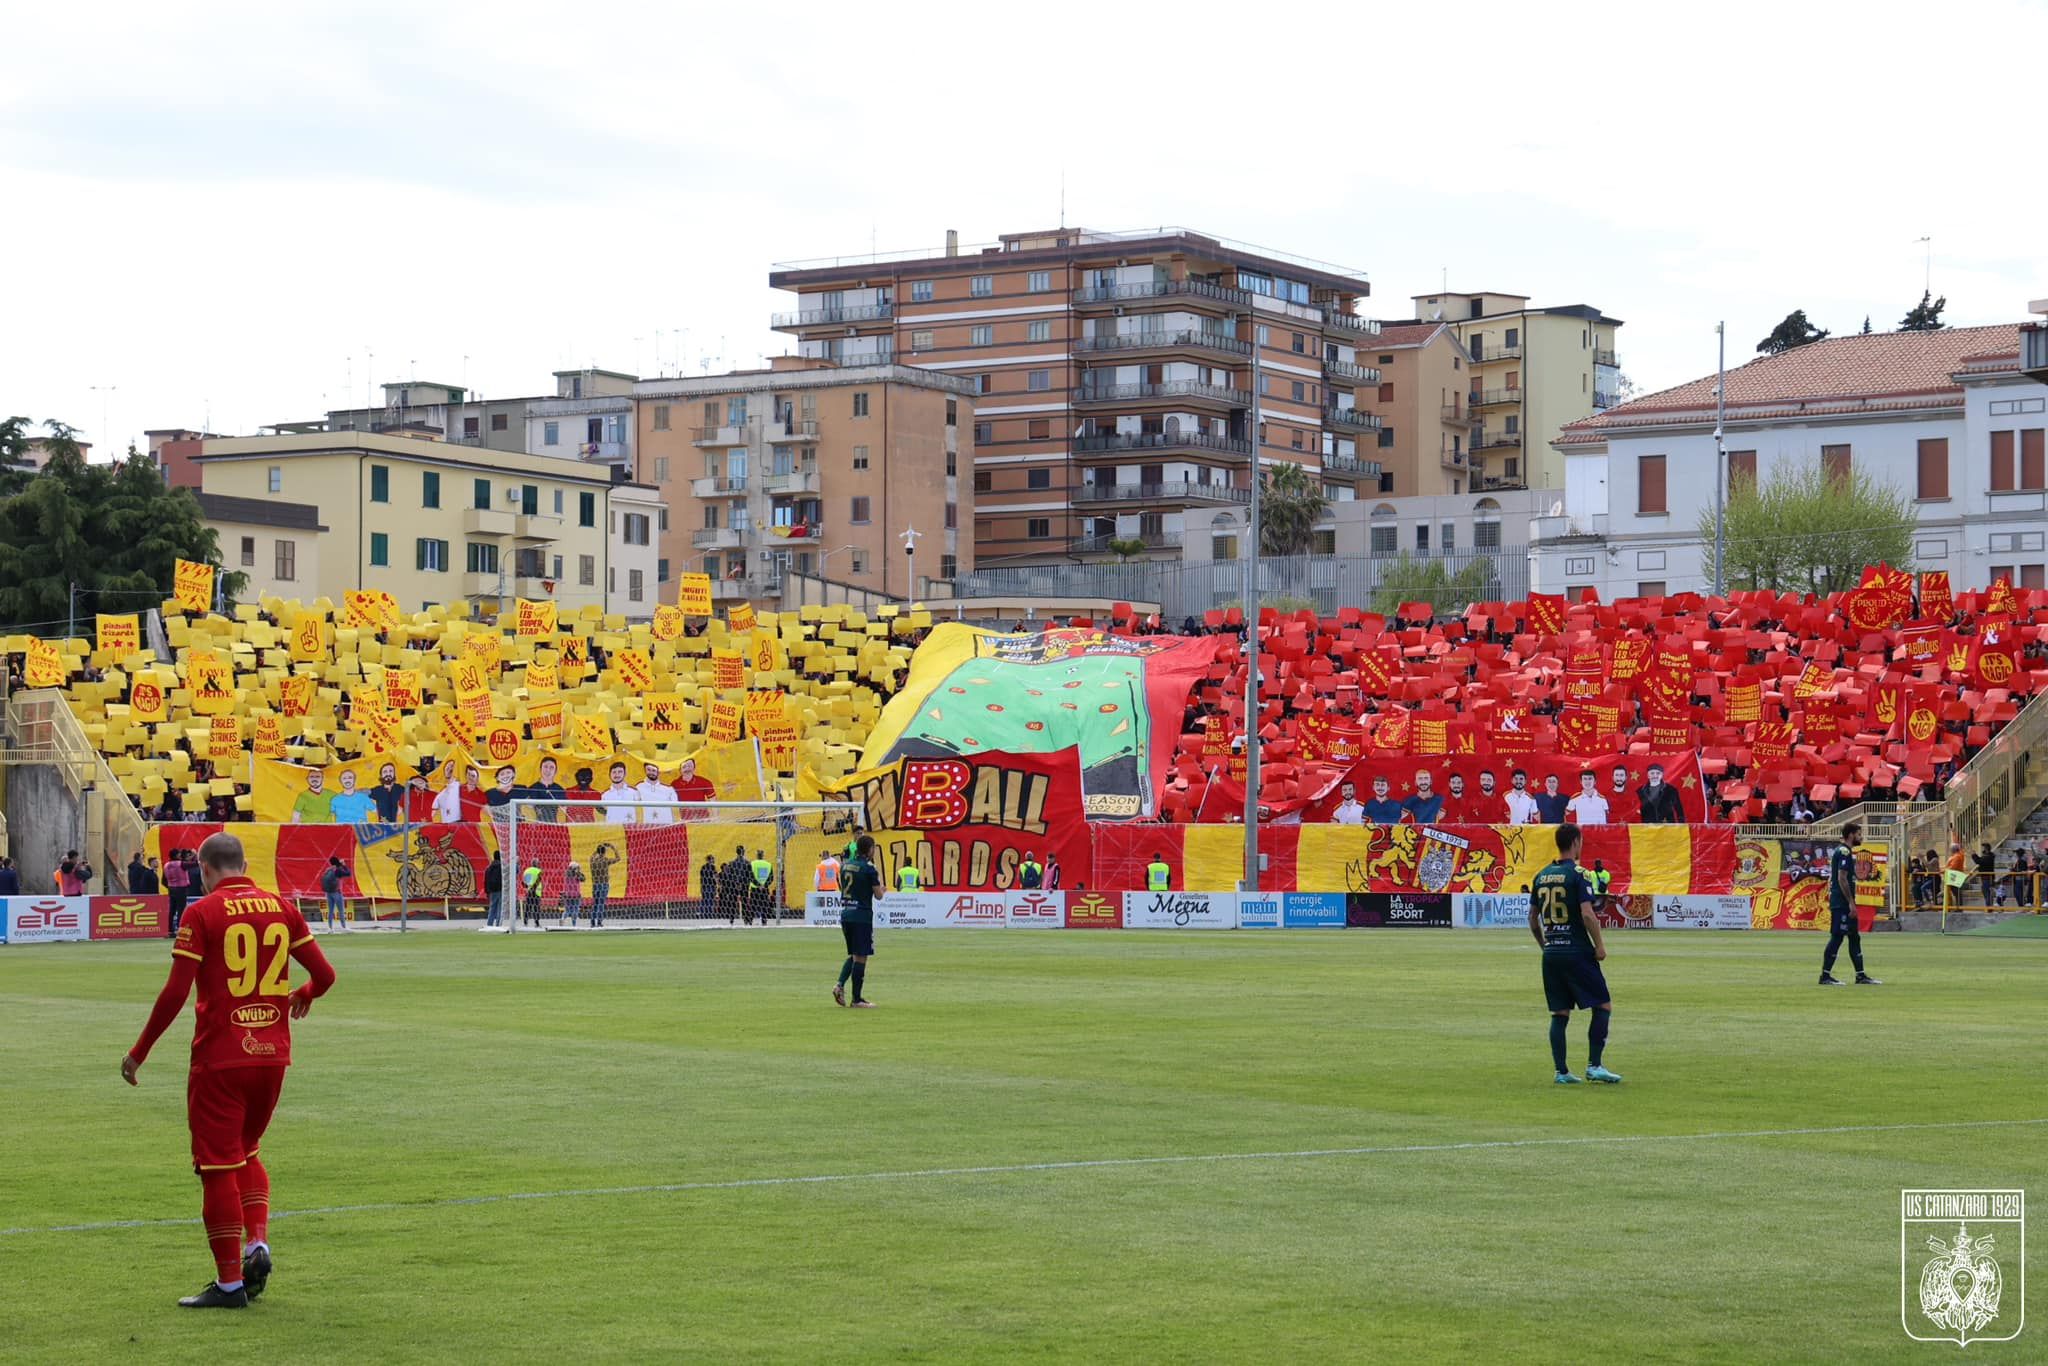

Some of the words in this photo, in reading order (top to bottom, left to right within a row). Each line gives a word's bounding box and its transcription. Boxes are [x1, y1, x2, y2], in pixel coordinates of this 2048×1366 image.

[520, 611, 531, 619] LES
[104, 622, 132, 631] pinball
[663, 620, 673, 628] OF
[1981, 624, 2006, 634] LOVE
[1984, 630, 1999, 645] &
[560, 639, 584, 647] LOVE
[1616, 640, 1631, 650] EAG
[1905, 641, 1939, 654] FABULOUS
[564, 647, 580, 660] &
[1614, 650, 1629, 659] LES
[1660, 652, 1688, 661] pinball
[559, 658, 584, 666] PRIDE
[1613, 660, 1638, 669] SUPER
[1984, 655, 2001, 667] IT'S
[200, 669, 226, 678] LOVE
[1611, 669, 1633, 678] STAR
[1982, 666, 2012, 681] MAGIC
[387, 680, 399, 688] LES
[1567, 682, 1600, 695] FABULOUS
[196, 690, 232, 699] PRIDE
[649, 703, 679, 711] LOVE
[713, 704, 737, 717] EAGLES
[653, 709, 671, 725] &
[1497, 708, 1526, 717] LOVE
[211, 717, 235, 729] EAGLES
[646, 722, 681, 732] PRIDE
[711, 717, 737, 730] STRIKES
[1501, 716, 1519, 732] &
[210, 731, 237, 743] STRIKES
[255, 729, 280, 740] STRIKES
[494, 730, 512, 742] IT'S
[764, 728, 794, 737] pinball
[1654, 728, 1687, 737] MIGHTY
[763, 735, 796, 743] wizards
[1654, 737, 1687, 745] EAGLES
[209, 745, 227, 756] AGAIN
[490, 742, 518, 758] MAGIC
[1327, 741, 1360, 756] FABULOUS
[822, 757, 1049, 835] PINBALL
[1087, 796, 1136, 804] EASON
[1289, 896, 1322, 907] energie
[1537, 886, 1569, 924] 26
[1148, 893, 1211, 926] Megna
[1241, 901, 1278, 914] main
[1289, 906, 1337, 917] rinnovabili
[1390, 910, 1424, 919] SPORT
[14, 927, 81, 936] eyesportwear.com
[95, 926, 161, 935] eyesportwear.com
[222, 922, 290, 998] 92
